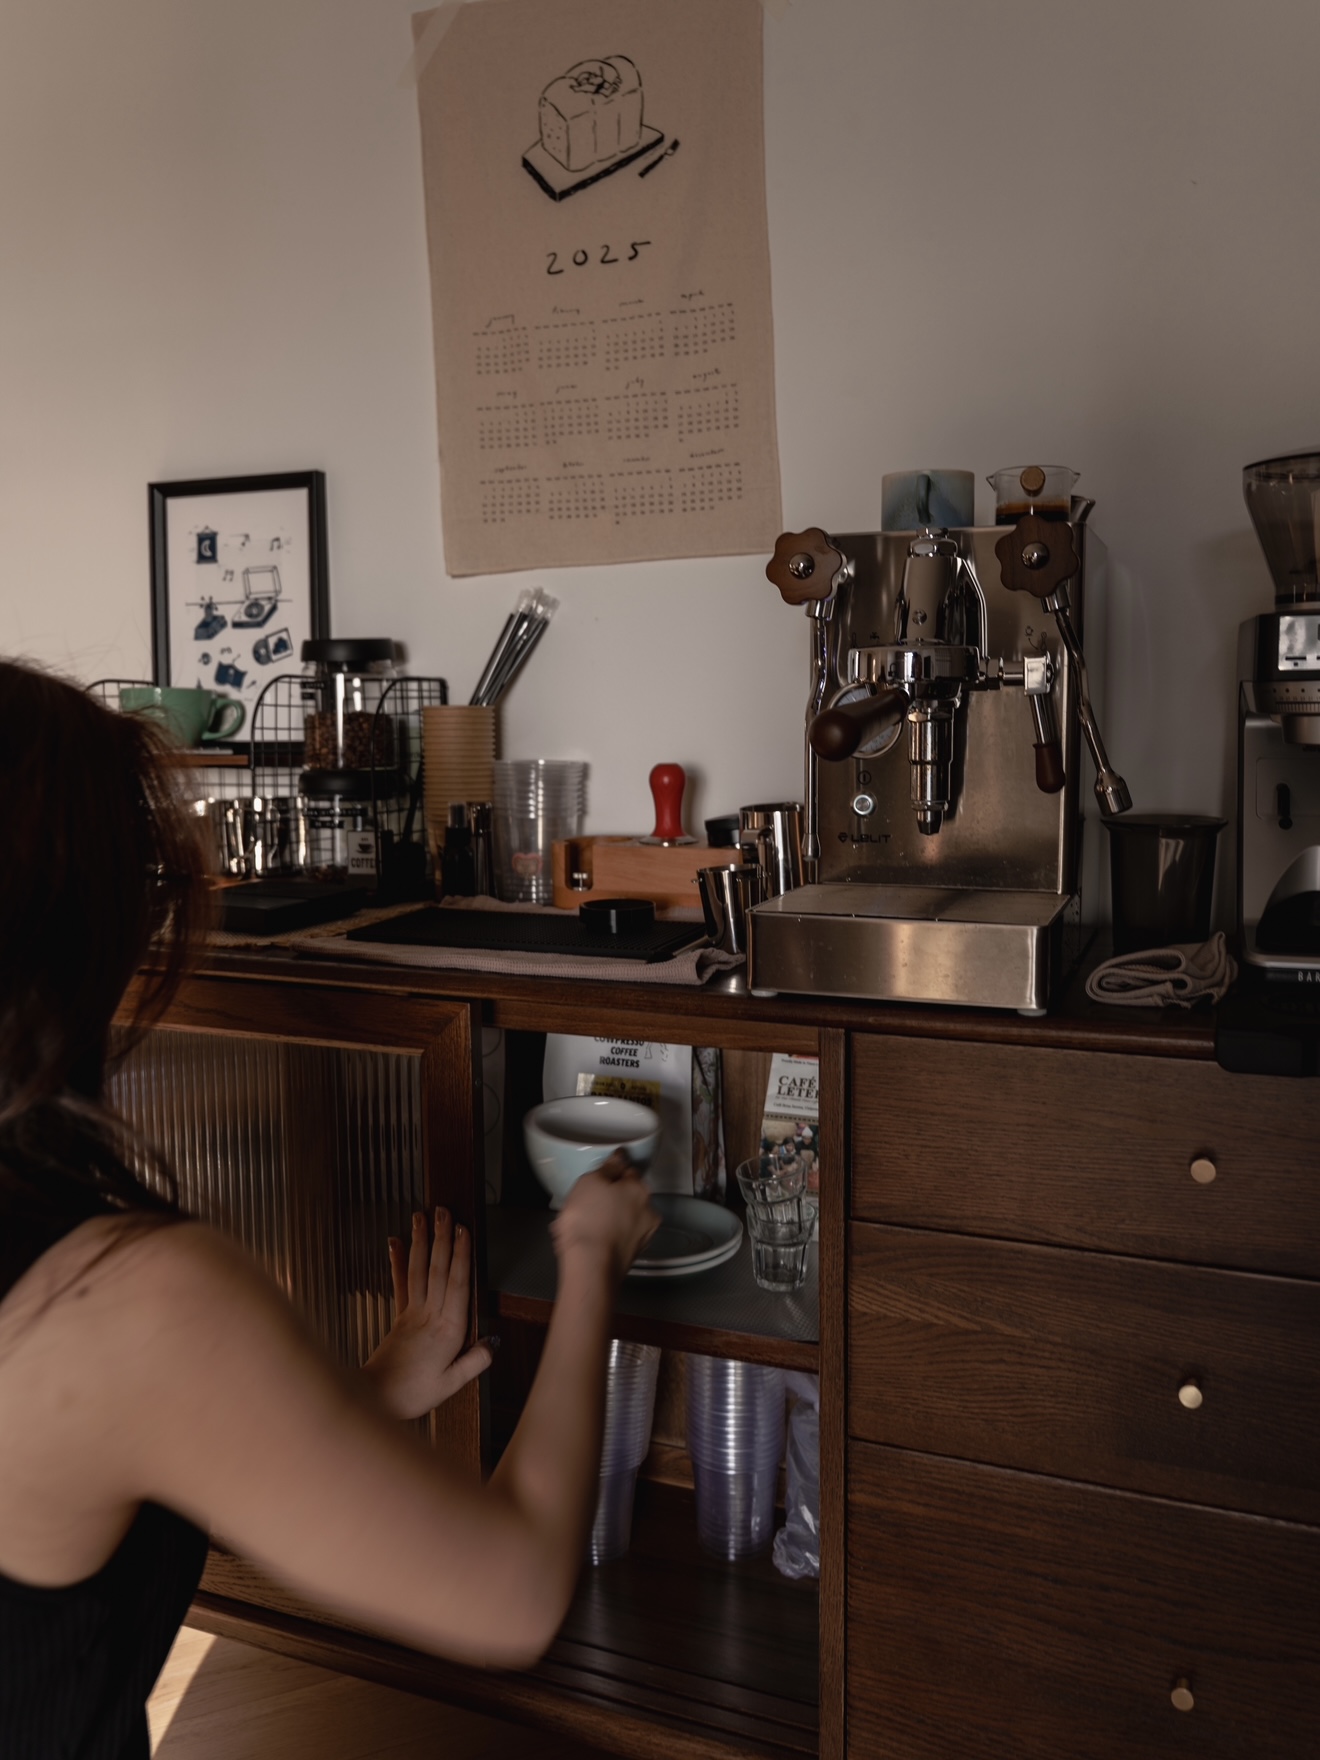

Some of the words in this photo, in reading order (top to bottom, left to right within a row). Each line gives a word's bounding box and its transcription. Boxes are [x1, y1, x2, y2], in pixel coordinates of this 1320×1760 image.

[546, 241, 651, 275] 2025
[610, 1046, 638, 1057] COFFEE
[599, 1056, 640, 1068] ROASTERS
[778, 1075, 817, 1089] CAFÉ
